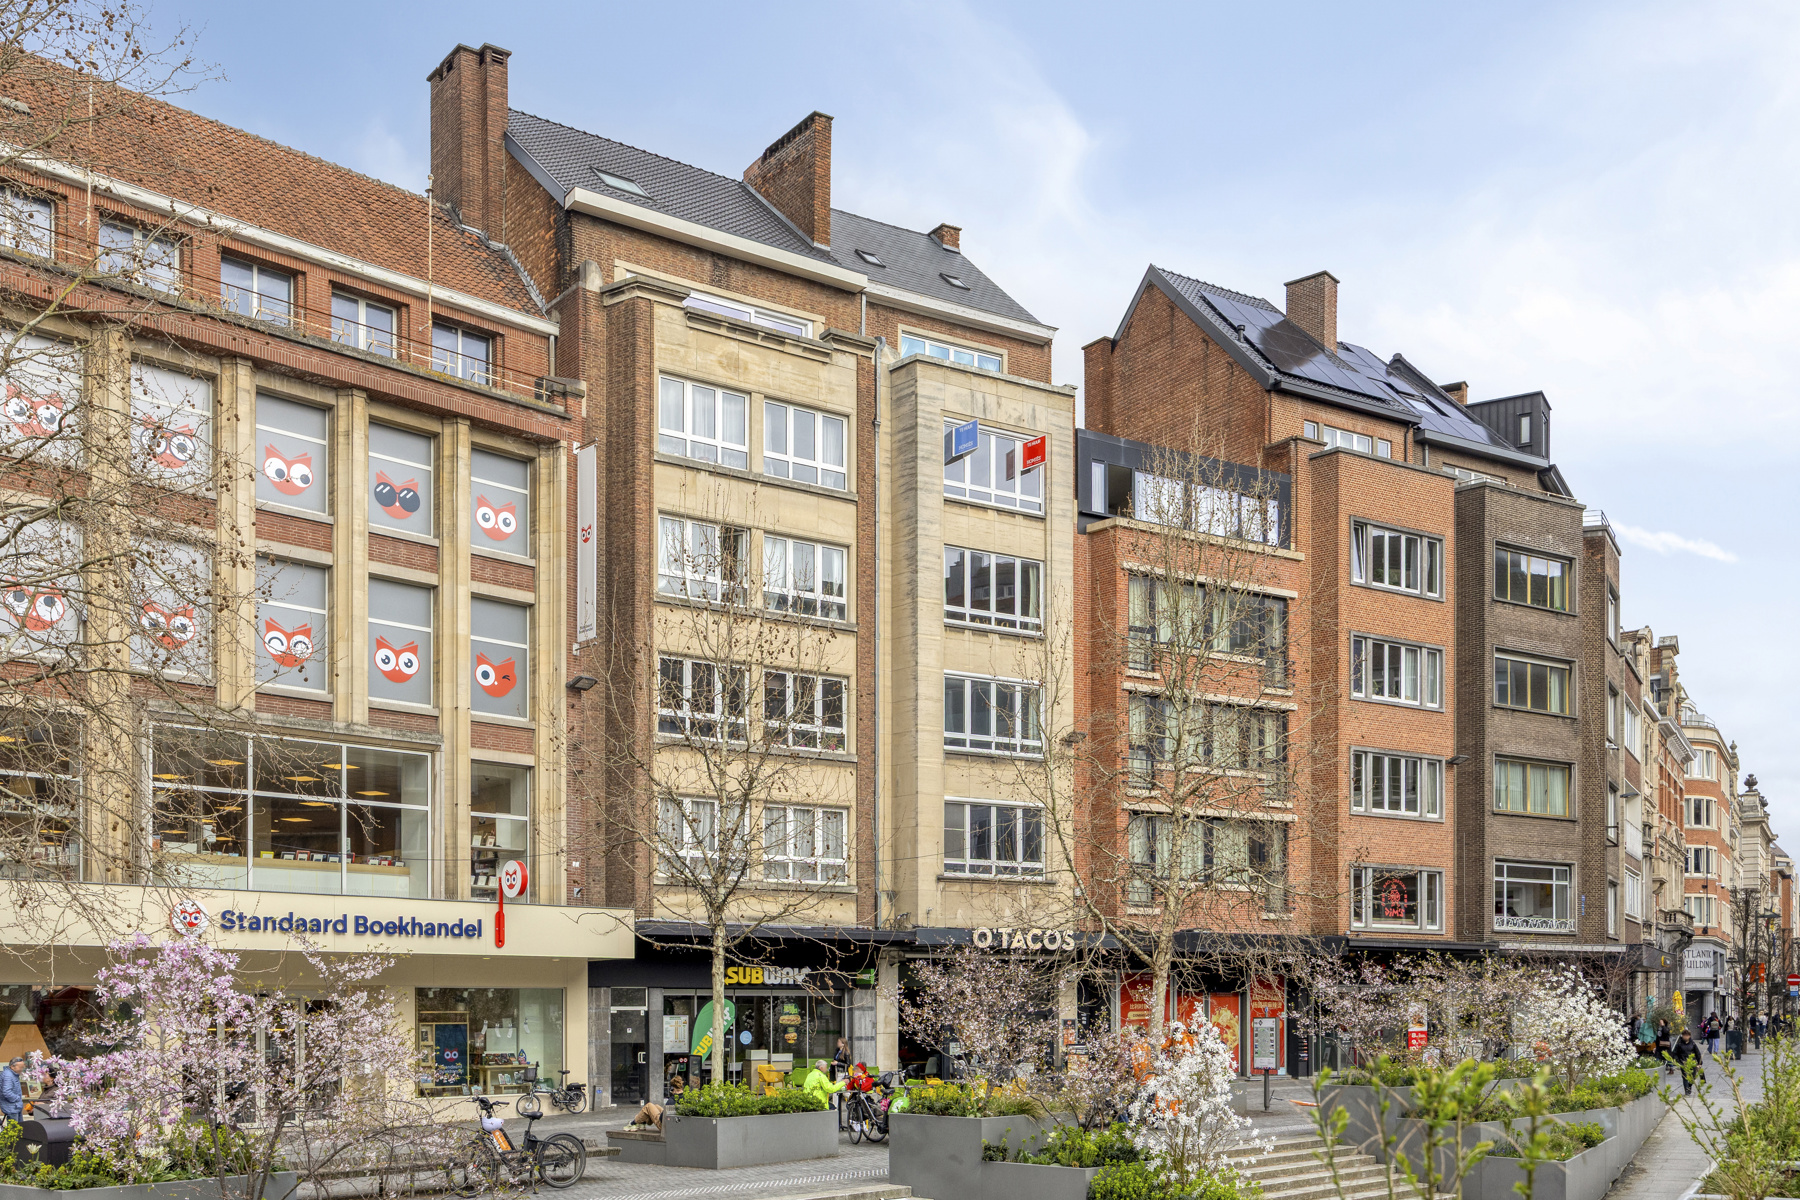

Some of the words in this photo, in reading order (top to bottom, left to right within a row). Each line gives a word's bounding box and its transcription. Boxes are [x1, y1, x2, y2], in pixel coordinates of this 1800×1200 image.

[220, 909, 348, 934] Standaard
[354, 915, 483, 938] Boekhandel
[724, 966, 812, 986] SUBWAY
